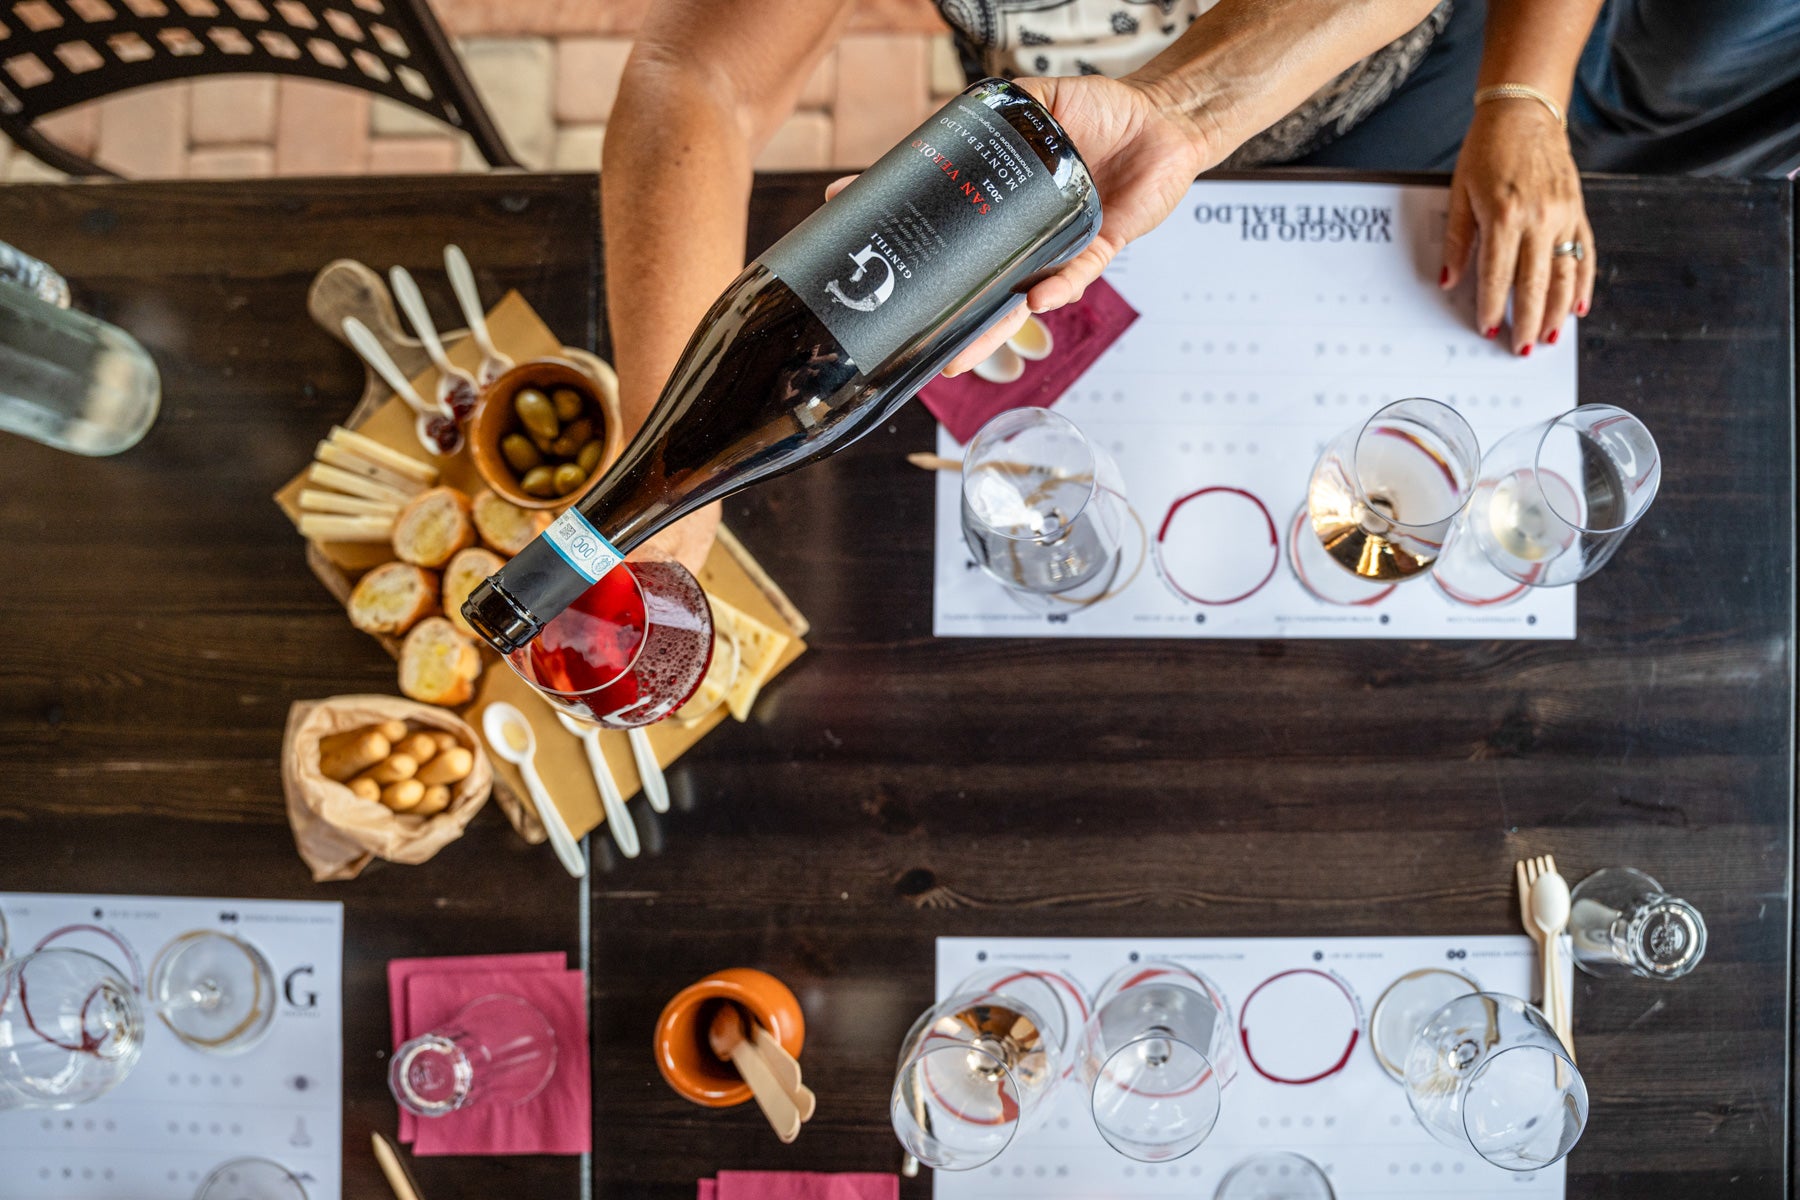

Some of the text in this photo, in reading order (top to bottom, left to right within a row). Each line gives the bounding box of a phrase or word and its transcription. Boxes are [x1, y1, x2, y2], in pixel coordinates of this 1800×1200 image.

[978, 116, 996, 134] Origine
[939, 116, 1018, 191] MONTEBALDO
[988, 137, 1025, 183] Bardolino
[999, 136, 1033, 177] Denominazione
[911, 138, 991, 215] SAN VEROLO
[982, 178, 1003, 203] 2021
[1194, 204, 1391, 225] MONTE BALDO
[1242, 222, 1392, 243] VIAGGIO DI
[870, 232, 912, 279] GENTILI
[573, 537, 595, 559] DOC
[284, 965, 321, 1010] G
